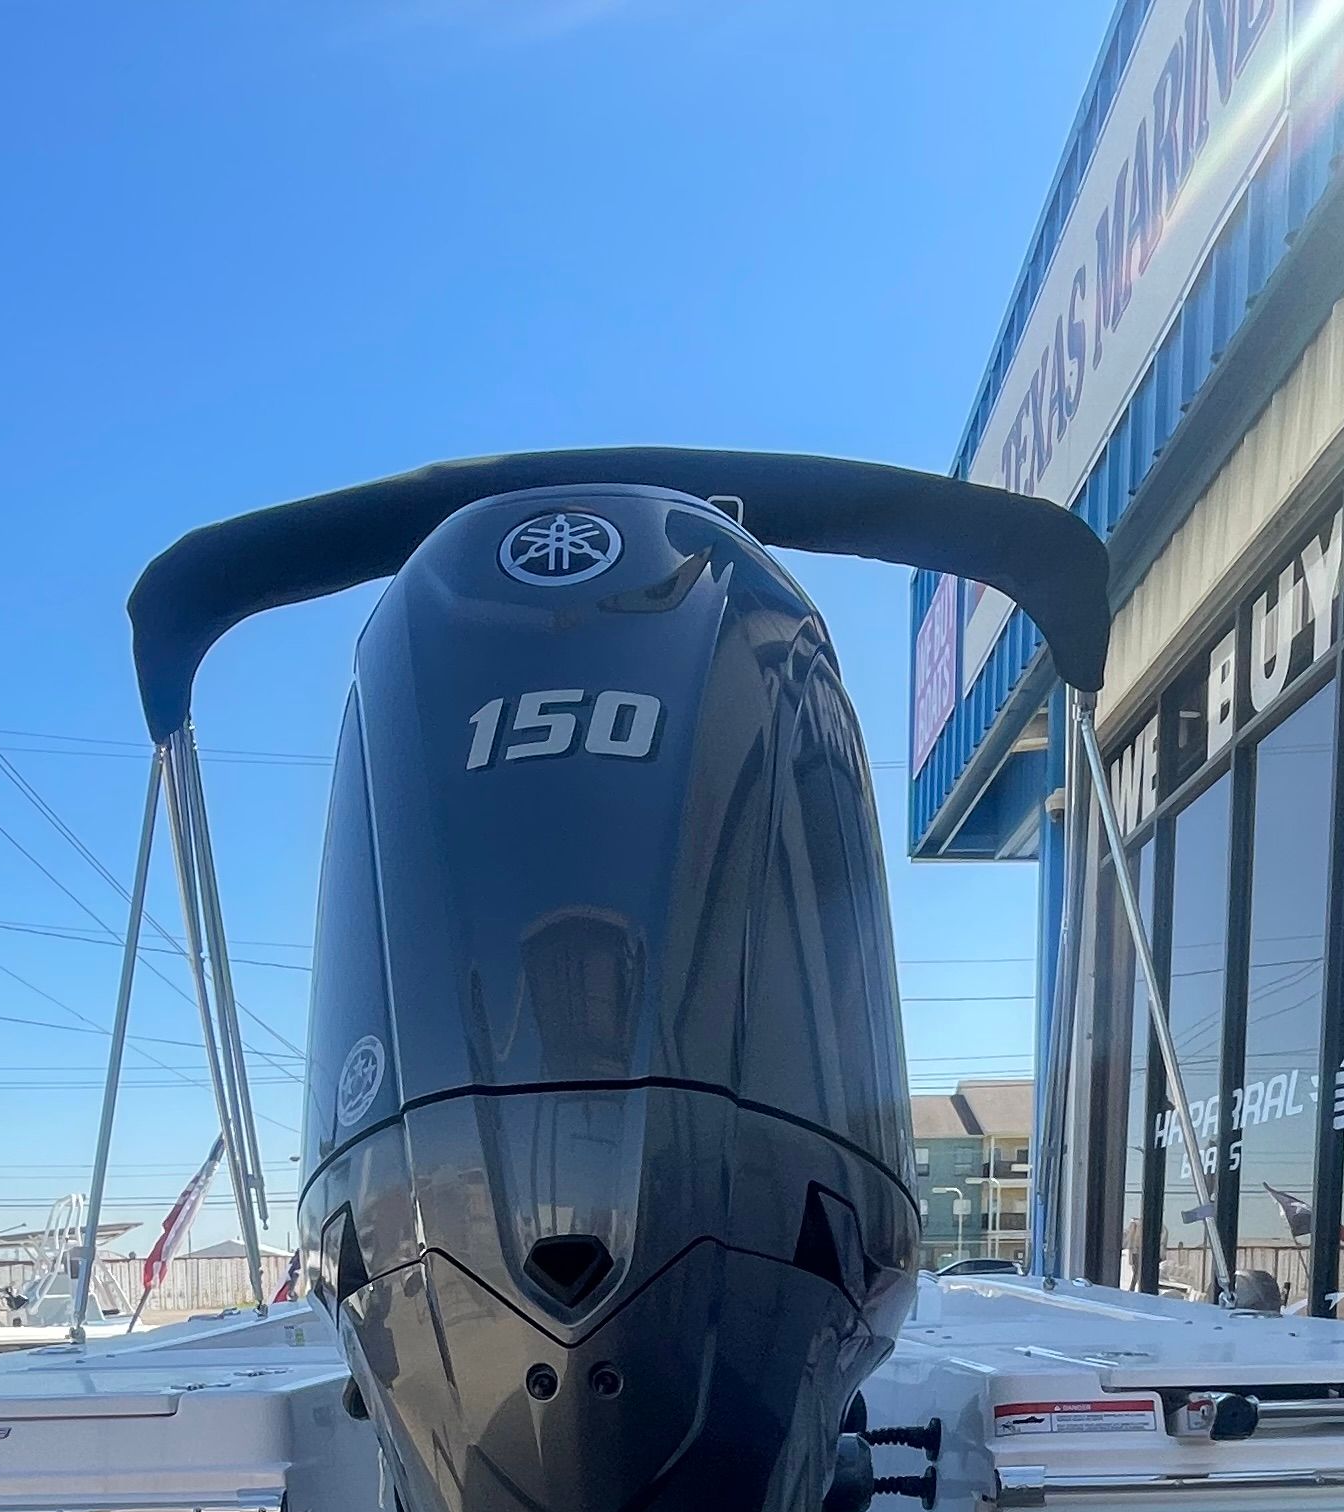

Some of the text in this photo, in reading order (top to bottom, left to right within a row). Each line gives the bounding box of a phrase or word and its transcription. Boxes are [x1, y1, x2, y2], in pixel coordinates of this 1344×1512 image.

[1110, 713, 1159, 837] WE
[1207, 507, 1343, 759] BUY
[466, 689, 661, 770] 150
[1154, 1070, 1304, 1149] HAPARRAL
